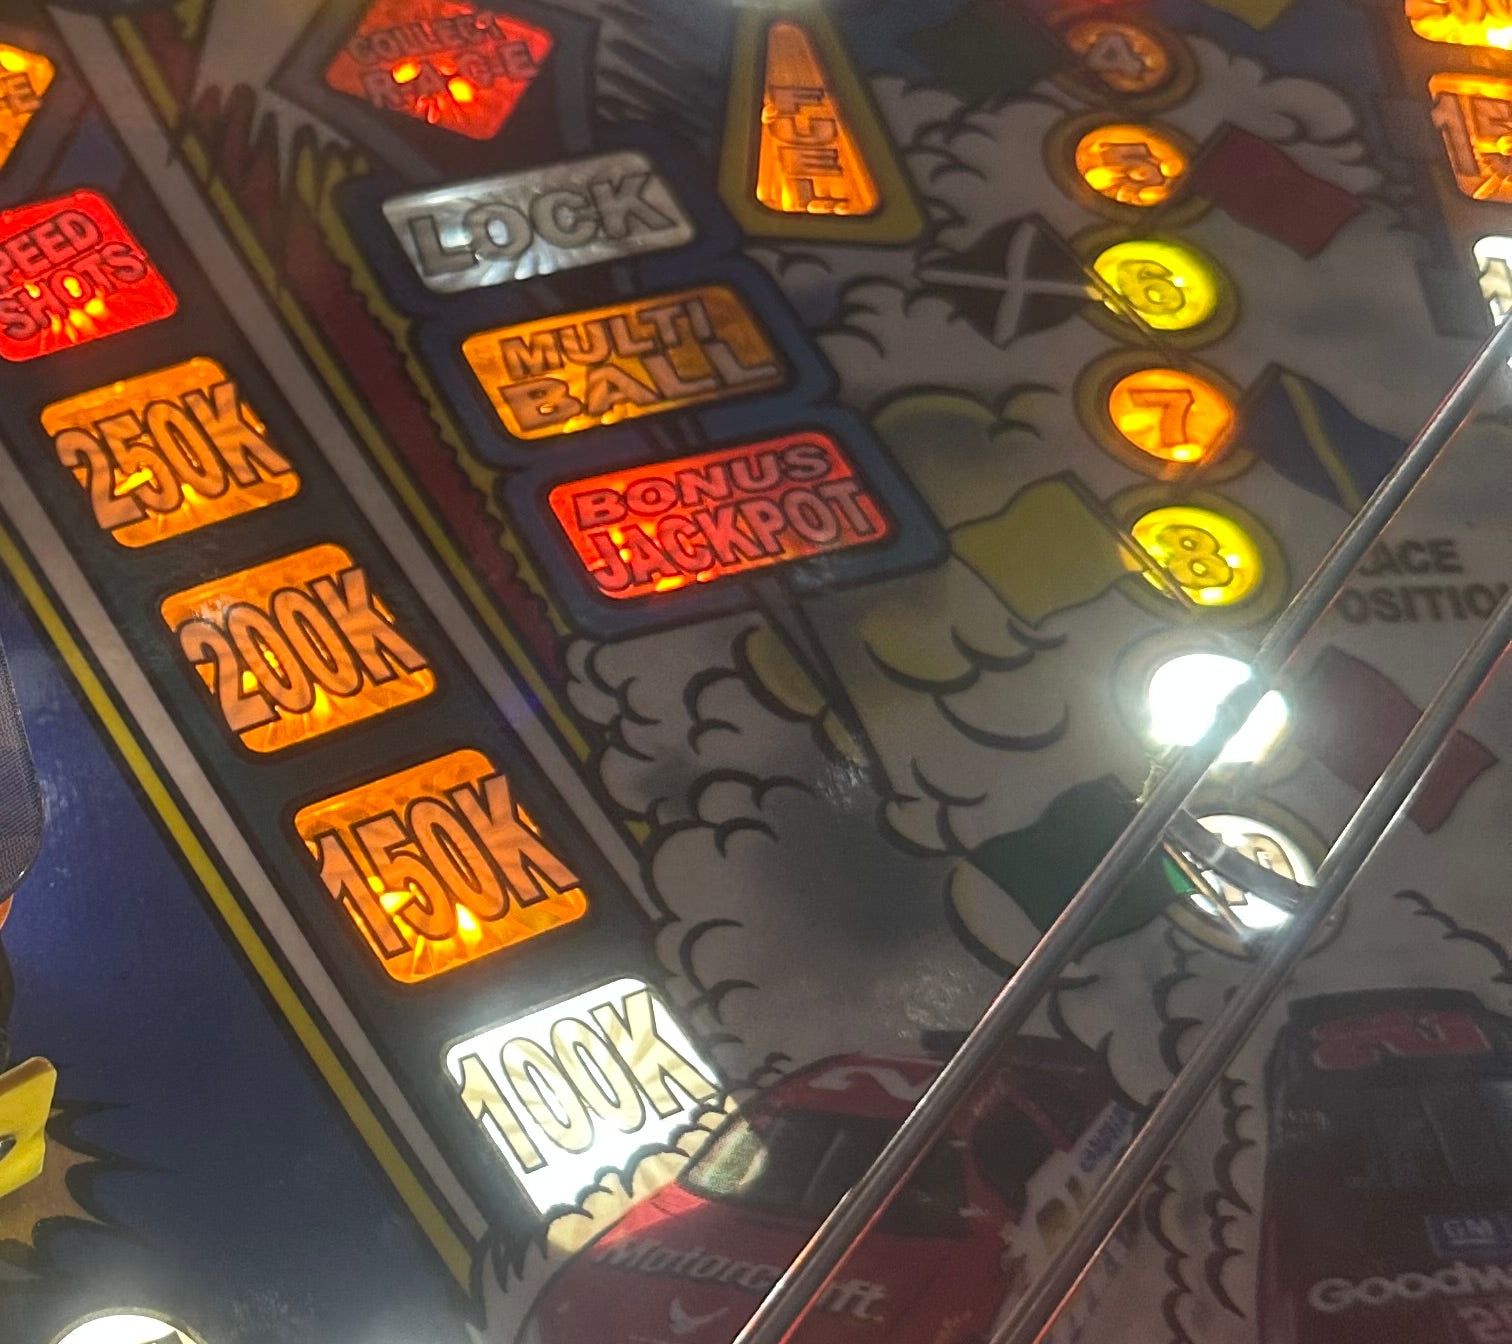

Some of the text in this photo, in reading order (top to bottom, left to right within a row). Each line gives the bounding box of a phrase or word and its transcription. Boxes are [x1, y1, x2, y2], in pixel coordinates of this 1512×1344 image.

[769, 84, 848, 212] FUEL
[408, 169, 679, 275] LOCK
[500, 297, 712, 380] MULTI
[1117, 258, 1186, 316] 6
[496, 324, 780, 434] BALL
[1126, 387, 1196, 450] 7
[55, 375, 289, 532] 250K
[574, 443, 834, 531] BONUS
[589, 482, 879, 592] JACKPOT
[1155, 522, 1235, 590] 8
[1352, 539, 1465, 578] ACE
[179, 565, 430, 733] 200K
[1337, 581, 1512, 626] OSITIO
[316, 772, 581, 958] 150K
[455, 987, 720, 1176] 100K
